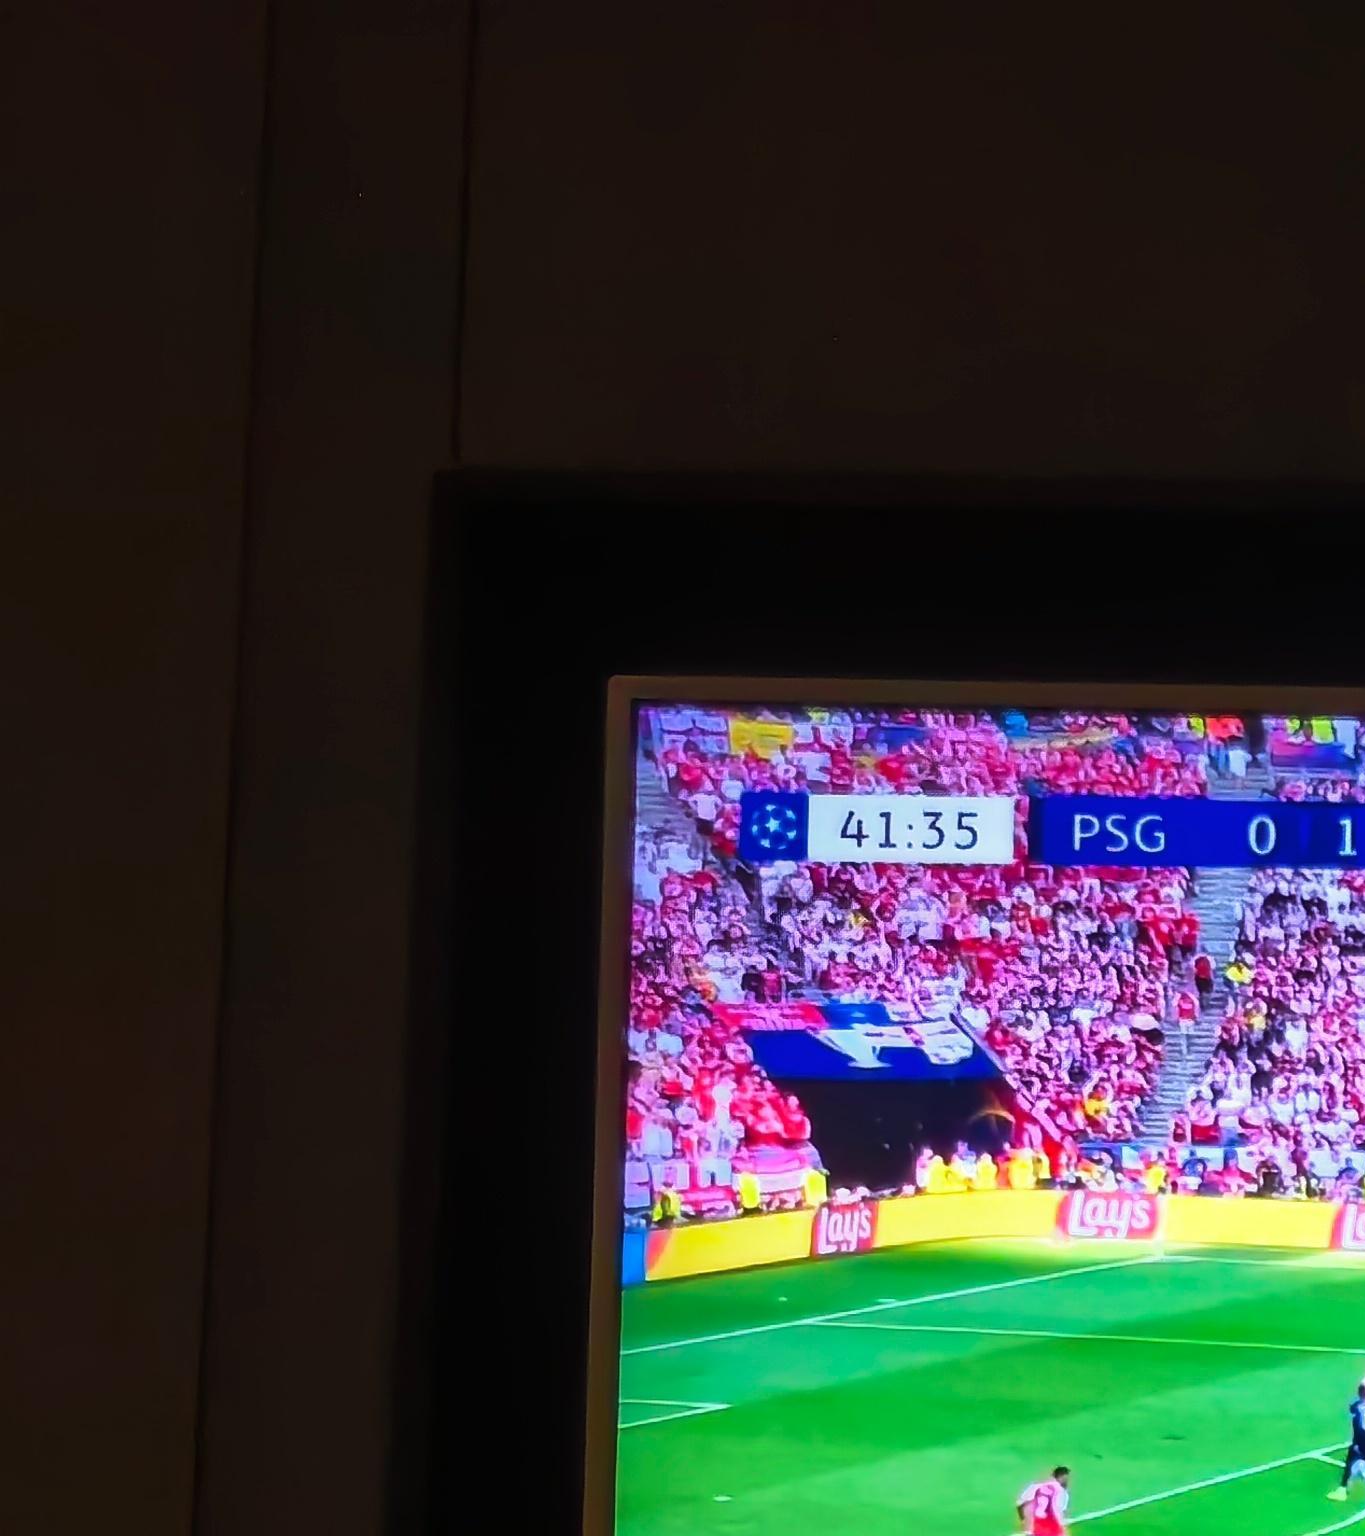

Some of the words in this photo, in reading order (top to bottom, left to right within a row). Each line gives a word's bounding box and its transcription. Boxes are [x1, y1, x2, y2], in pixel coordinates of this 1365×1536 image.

[840, 811, 979, 850] 41:35
[1073, 814, 1166, 852] PSG
[1247, 815, 1277, 856] 0
[1338, 817, 1358, 857] 1
[817, 1204, 873, 1254] Lay's
[1068, 1189, 1149, 1238] Lay's
